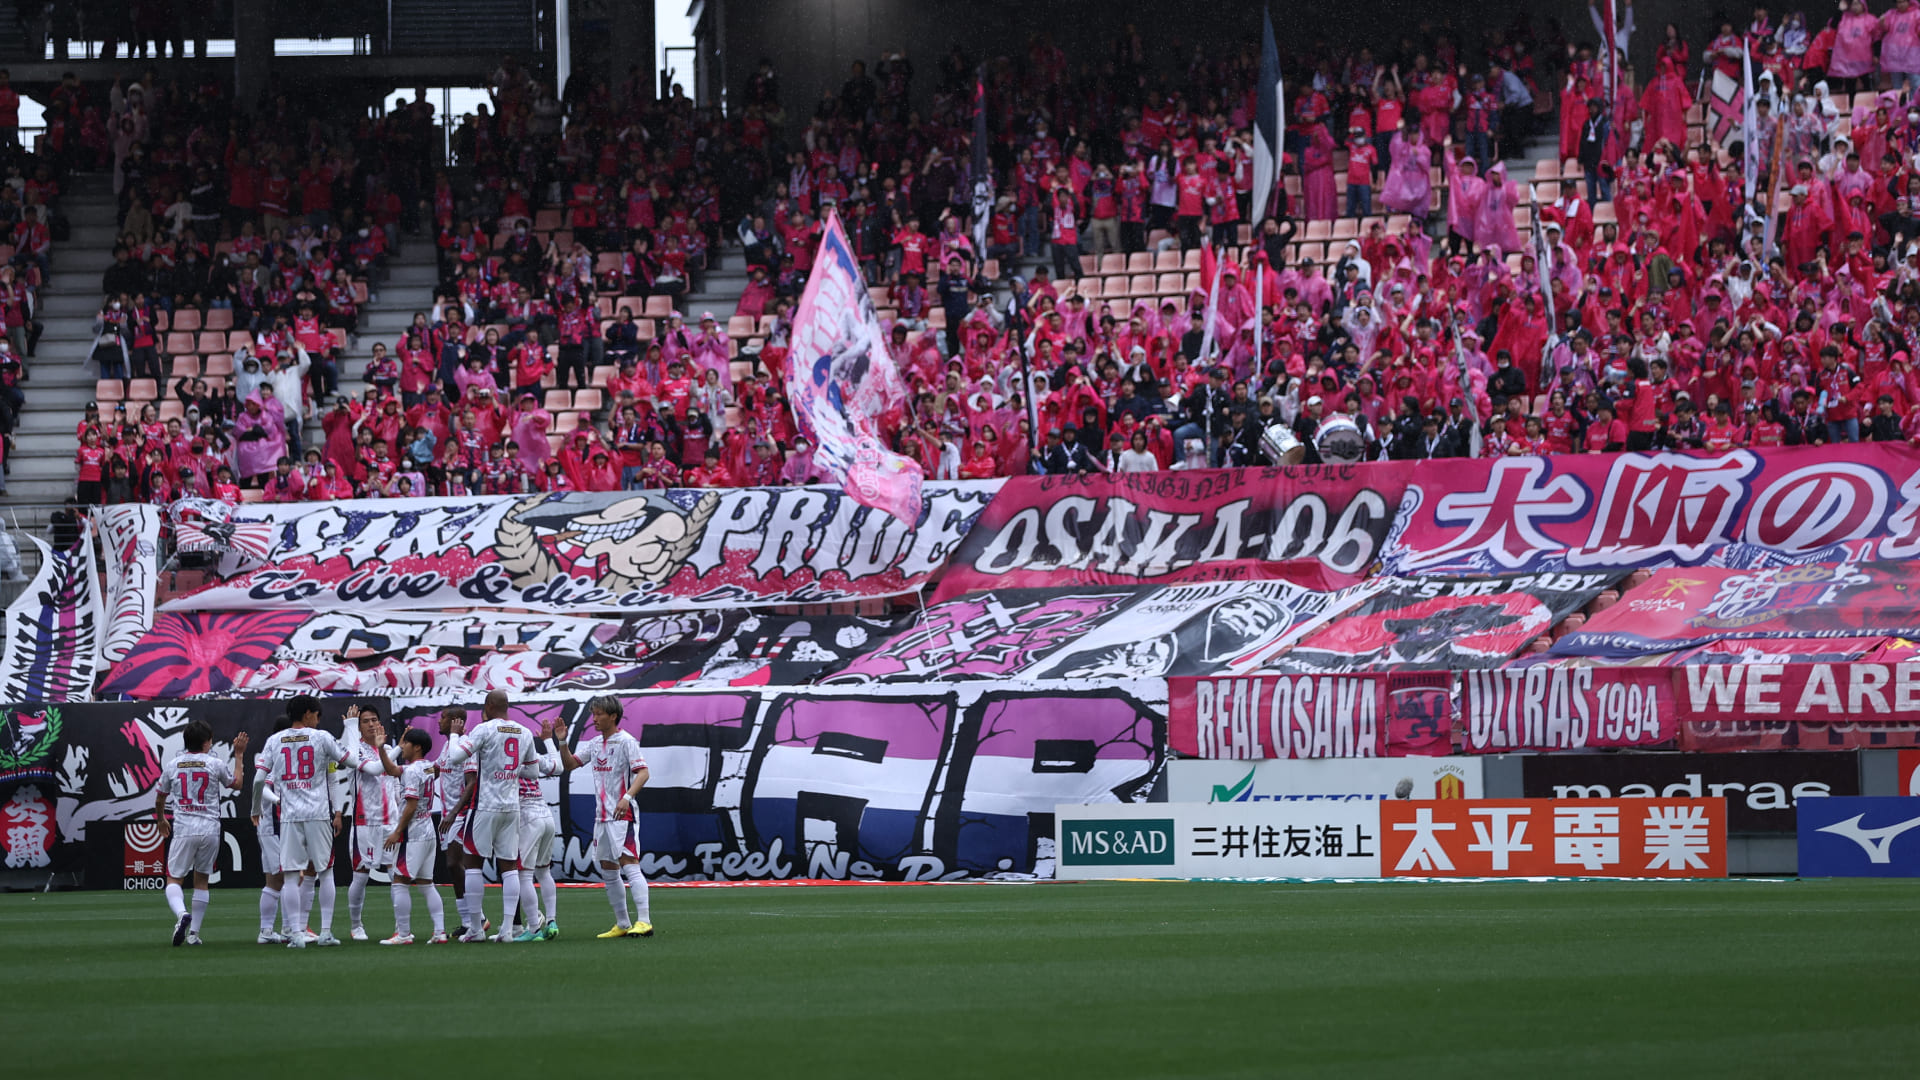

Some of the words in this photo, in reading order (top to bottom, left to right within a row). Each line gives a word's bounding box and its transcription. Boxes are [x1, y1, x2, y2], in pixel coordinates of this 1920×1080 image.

[1106, 468, 1246, 500] ORIGINAL
[974, 488, 1386, 576] OSAKA-06
[337, 564, 447, 602] live
[459, 563, 512, 603] &
[521, 574, 613, 605] die
[1686, 664, 1785, 714] WE
[1795, 663, 1920, 714] ARE
[1196, 679, 1265, 760] REAL
[1270, 676, 1378, 760] OSAKA
[1468, 667, 1593, 750] ULTRAS
[1596, 682, 1660, 742] 1994
[280, 745, 316, 781] 18
[504, 737, 520, 771] 9
[1432, 764, 1465, 778] NAGOYA
[177, 771, 210, 805] 17
[1552, 773, 1831, 810] madras
[366, 847, 374, 860] 4
[1070, 829, 1168, 856] MS&AD
[1191, 824, 1375, 859] 三井住友海上
[1392, 805, 1712, 871] 太平電業
[125, 860, 164, 874] 一期一会
[693, 837, 793, 880] Feel
[123, 876, 165, 890] ICHIGO
